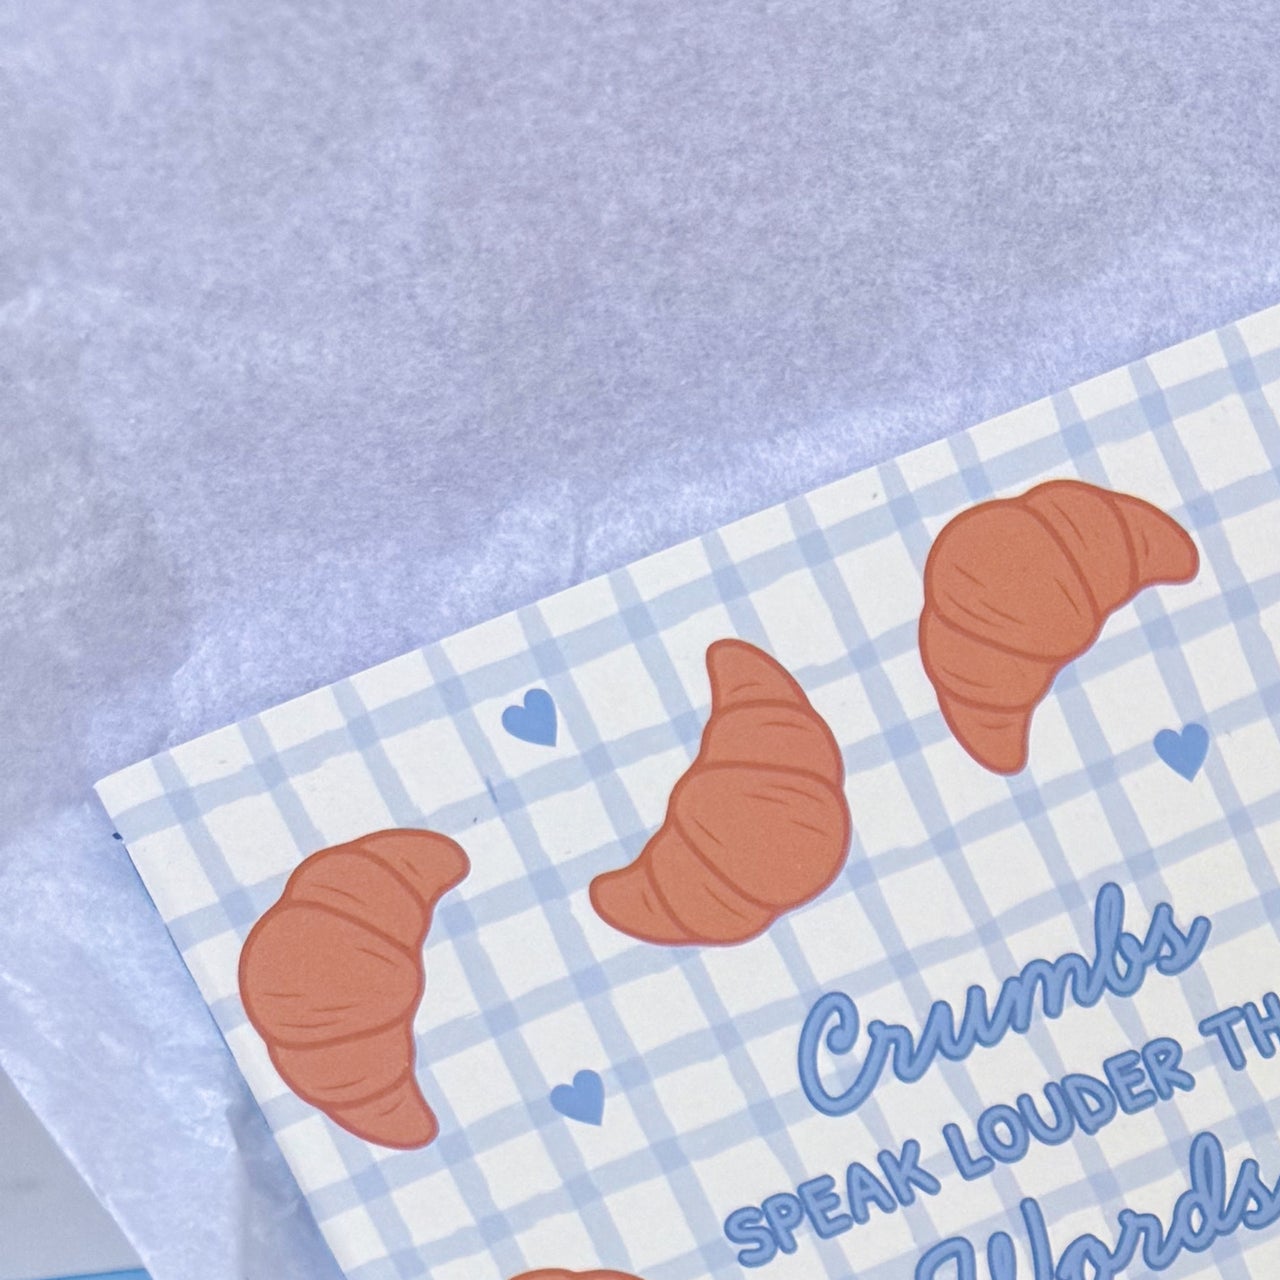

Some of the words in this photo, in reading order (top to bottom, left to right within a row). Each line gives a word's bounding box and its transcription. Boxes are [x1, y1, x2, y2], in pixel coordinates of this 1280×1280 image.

[798, 882, 1211, 1116] Crumbs
[724, 1140, 941, 1268] SPEAK
[942, 1037, 1196, 1181] LOUDER
